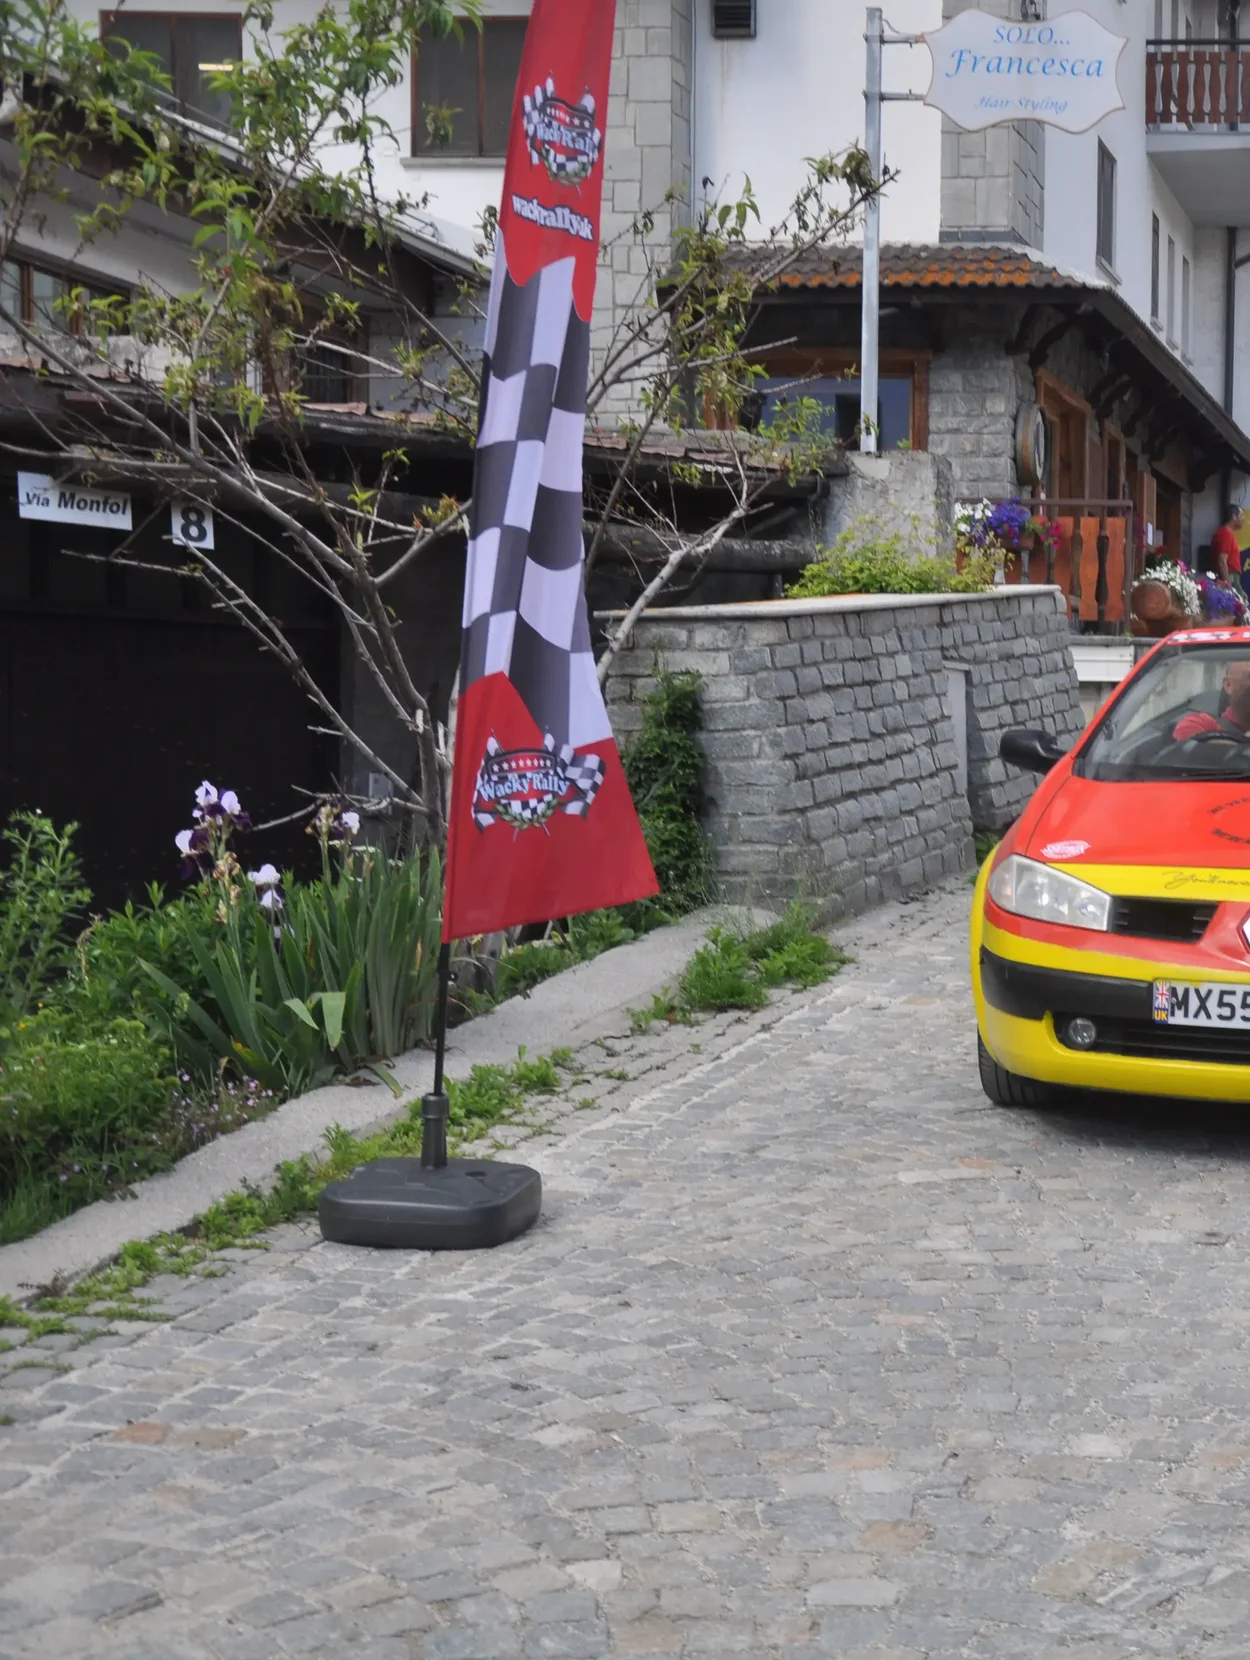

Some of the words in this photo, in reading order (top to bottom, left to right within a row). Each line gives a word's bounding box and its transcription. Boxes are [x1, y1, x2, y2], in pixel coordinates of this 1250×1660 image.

[993, 26, 1071, 46] SOLO...
[945, 49, 1103, 78] Francesca
[976, 96, 1010, 109] Hair
[1015, 97, 1068, 115] Styling
[536, 123, 562, 146] Wack
[25, 491, 50, 508] Via
[57, 491, 129, 516] Monfol
[180, 506, 207, 543] 8
[479, 771, 530, 802] Wacky
[532, 772, 570, 796] Rally
[1154, 1011, 1168, 1021] UK
